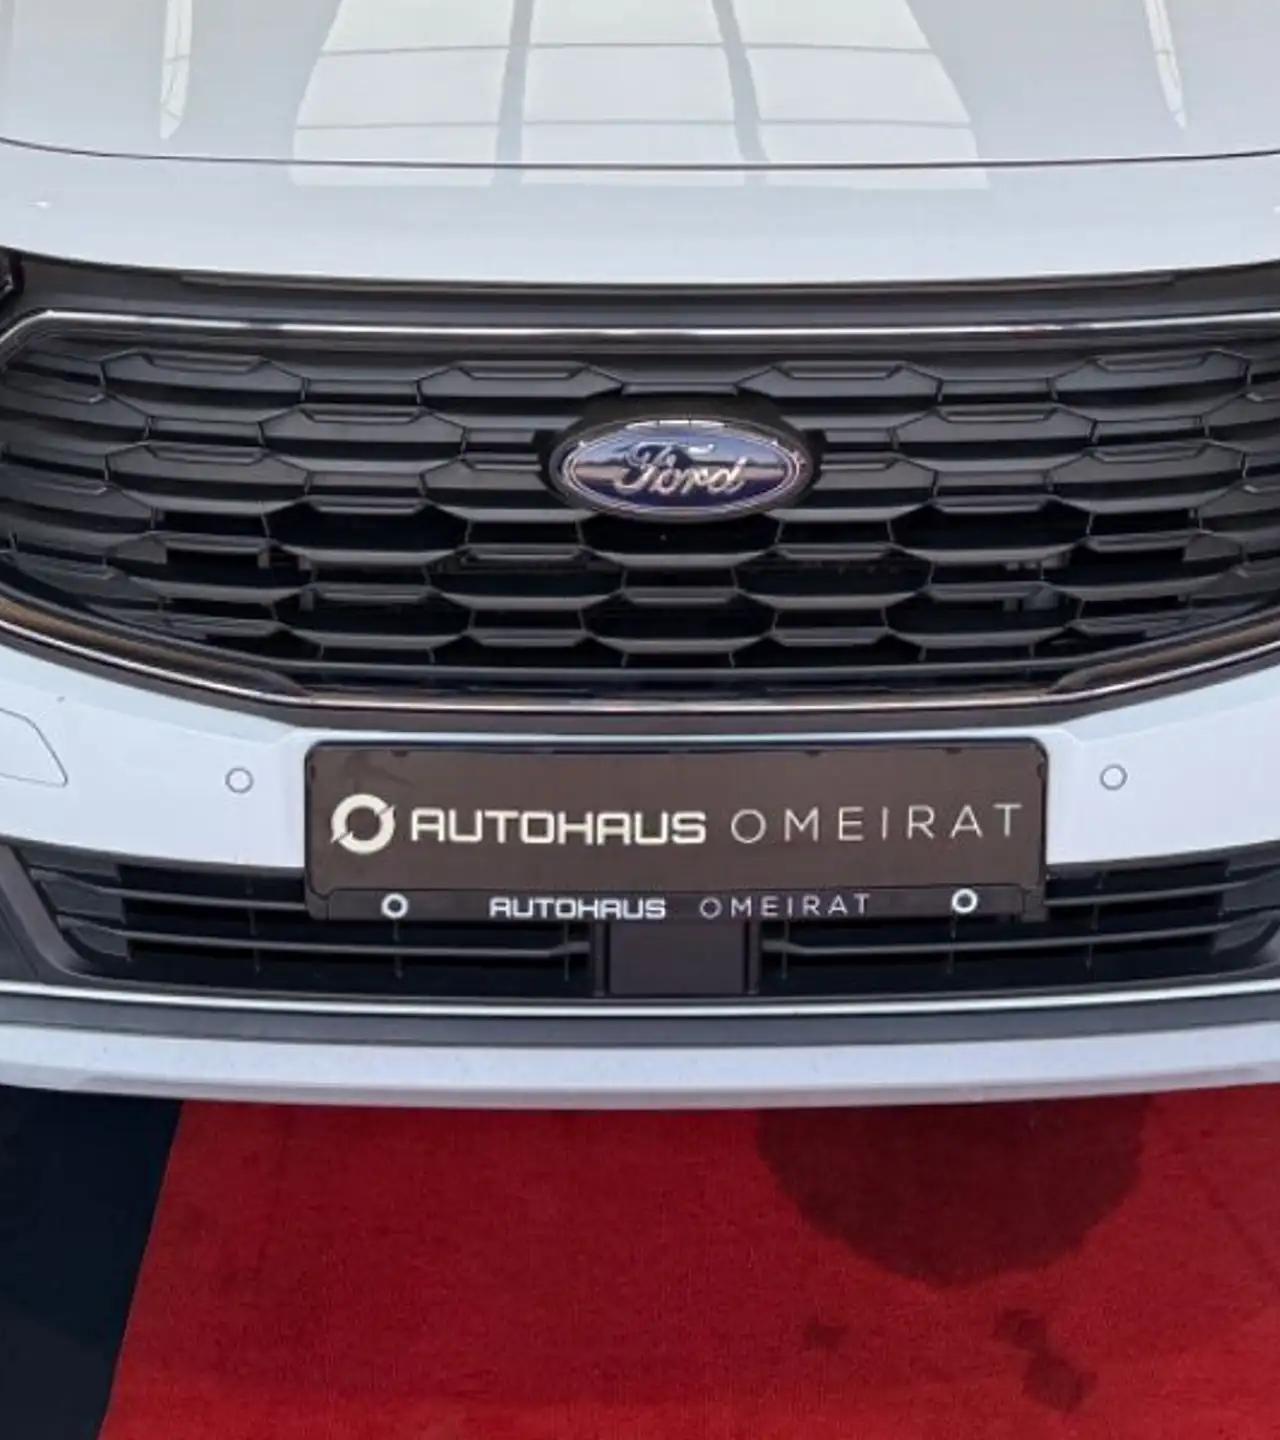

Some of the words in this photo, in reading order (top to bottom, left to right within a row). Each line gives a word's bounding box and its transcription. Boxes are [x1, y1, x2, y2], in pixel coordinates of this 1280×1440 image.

[612, 440, 748, 496] Ford
[410, 808, 707, 846] AUTOHAUS
[730, 803, 1023, 844] OMEIRAT
[489, 897, 666, 919] AUTOHAUS
[699, 893, 871, 919] OMEIRAT
